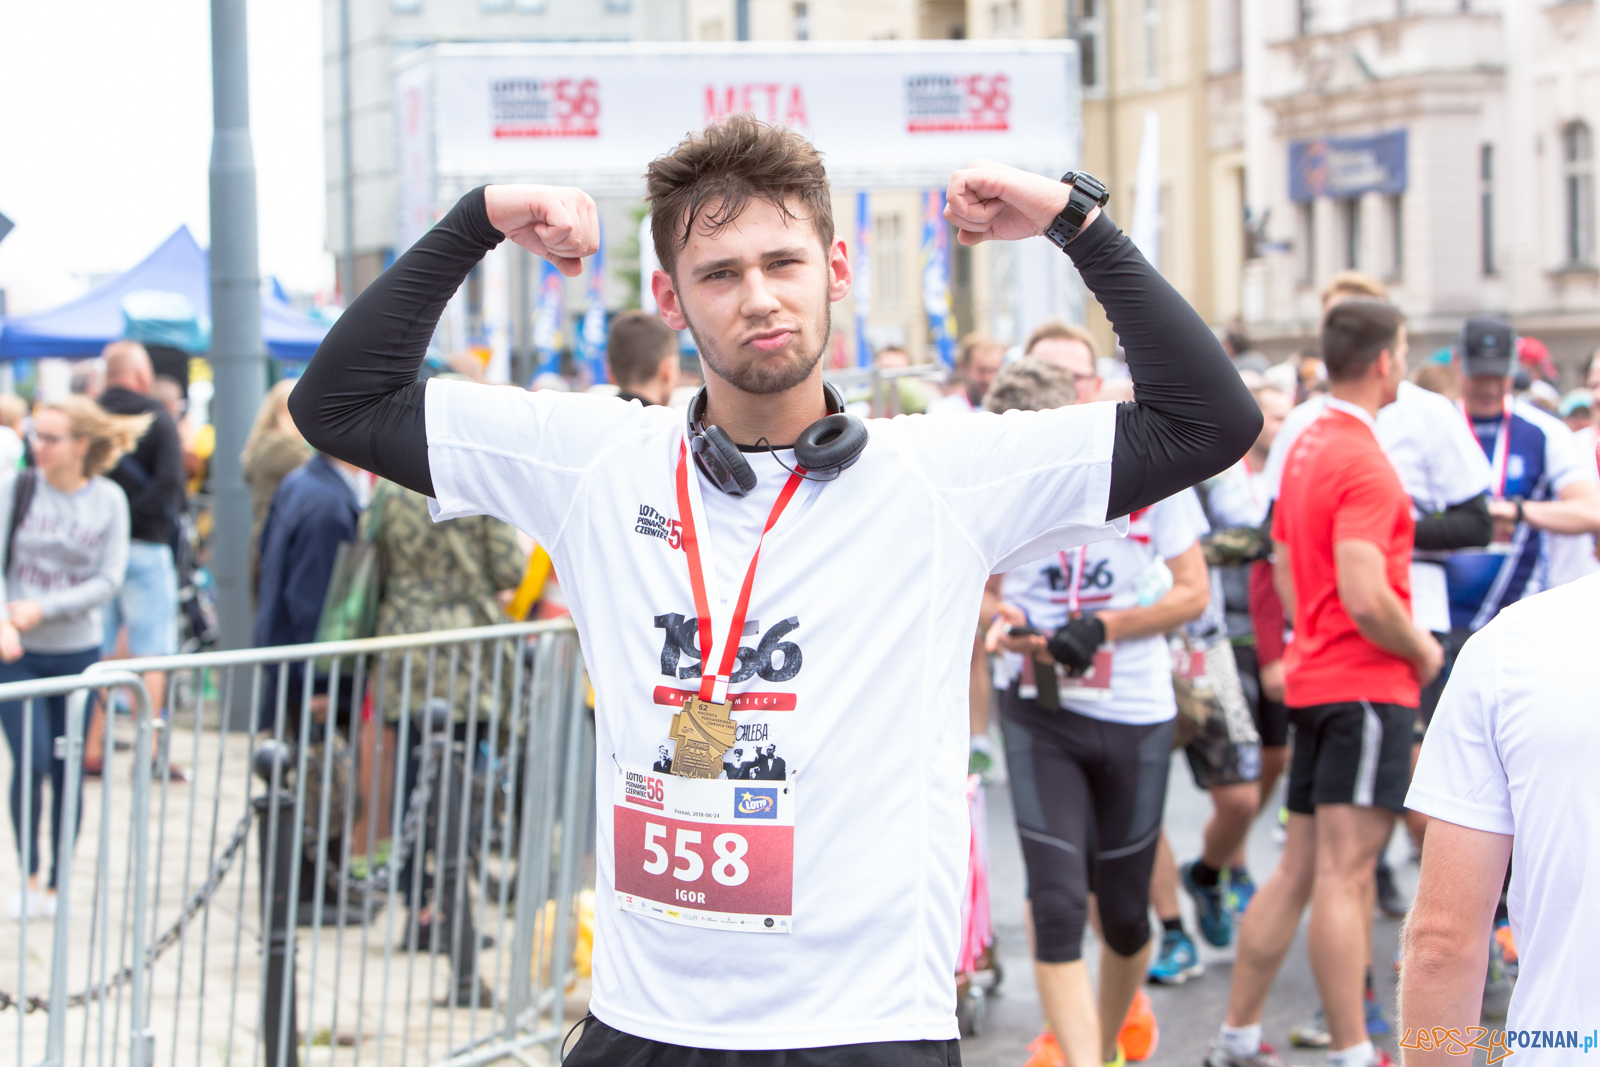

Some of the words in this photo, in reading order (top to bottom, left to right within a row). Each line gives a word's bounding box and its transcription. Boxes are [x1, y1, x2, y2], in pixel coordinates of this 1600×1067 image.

[704, 82, 809, 128] META
[639, 504, 666, 526] LOTTO
[665, 518, 687, 553] '5
[698, 703, 709, 712] 62
[626, 771, 643, 783] LOTTO
[625, 787, 647, 798] CZERWIEC
[745, 799, 767, 810] LOTTO
[692, 809, 720, 819] 2018-06-24
[642, 821, 749, 887] 558
[675, 888, 706, 904] IGOR
